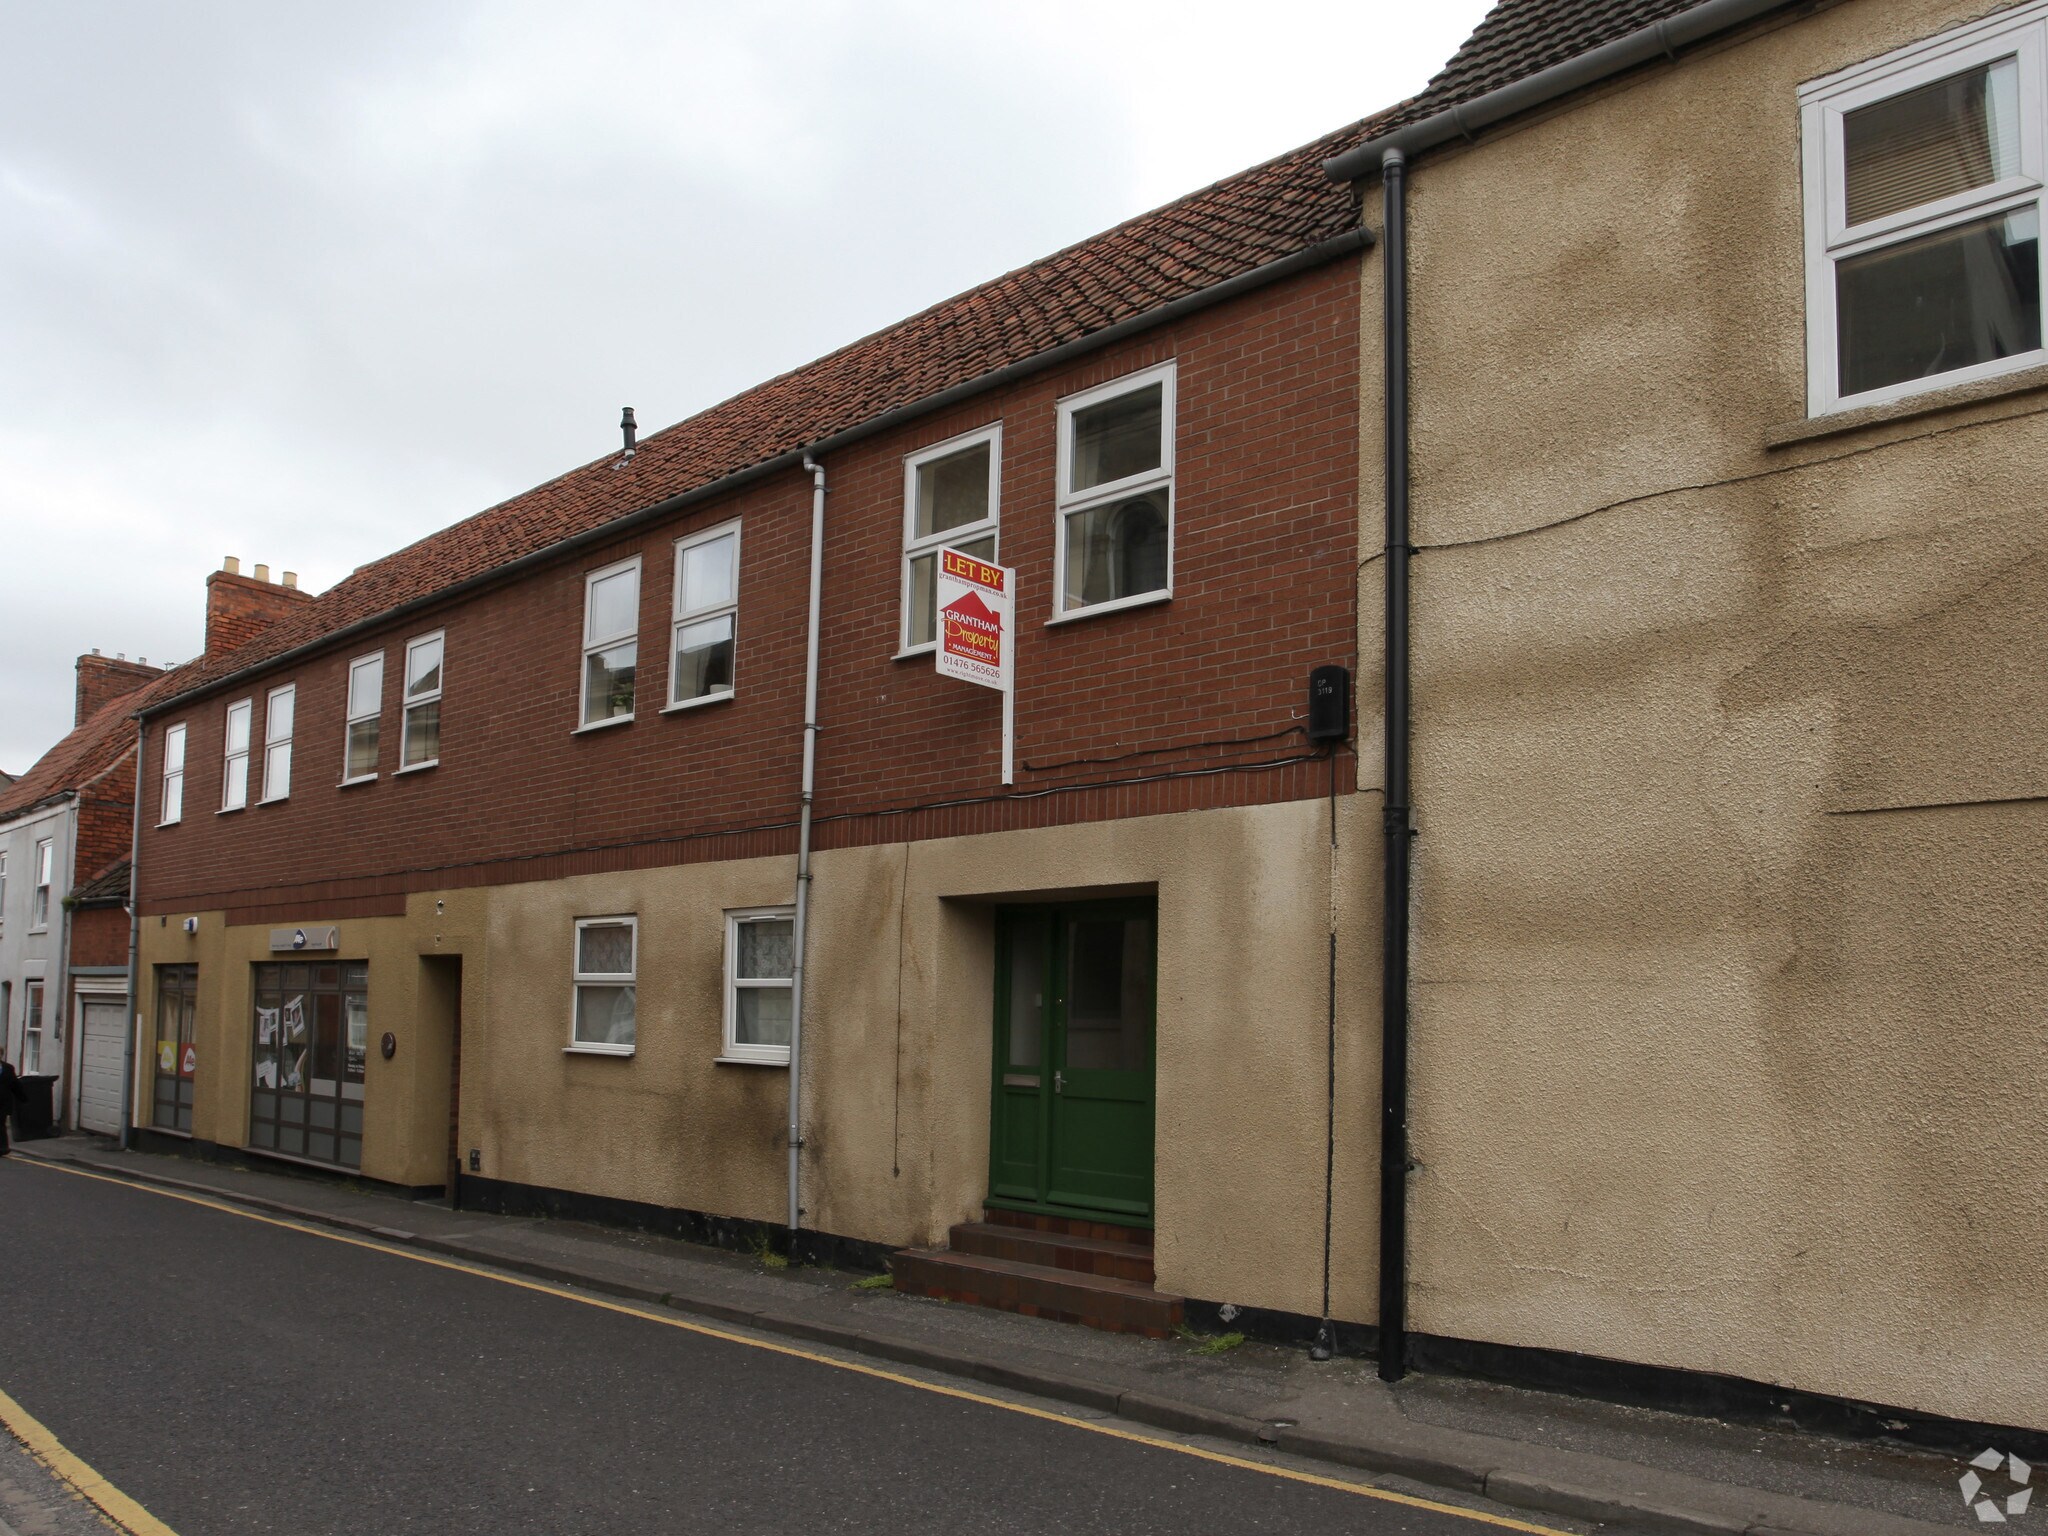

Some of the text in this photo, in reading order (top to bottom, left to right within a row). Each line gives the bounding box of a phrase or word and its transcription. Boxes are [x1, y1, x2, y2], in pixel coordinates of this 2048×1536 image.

[946, 554, 1000, 586] LET BY
[938, 572, 1008, 600] granthampropman.co.uk
[946, 609, 998, 634] GRANTHAM
[941, 618, 999, 658] Property
[952, 643, 992, 660] MANAGEMENT
[943, 655, 1000, 679] 01476 565626
[946, 668, 998, 685] www.rightmove.co.uk
